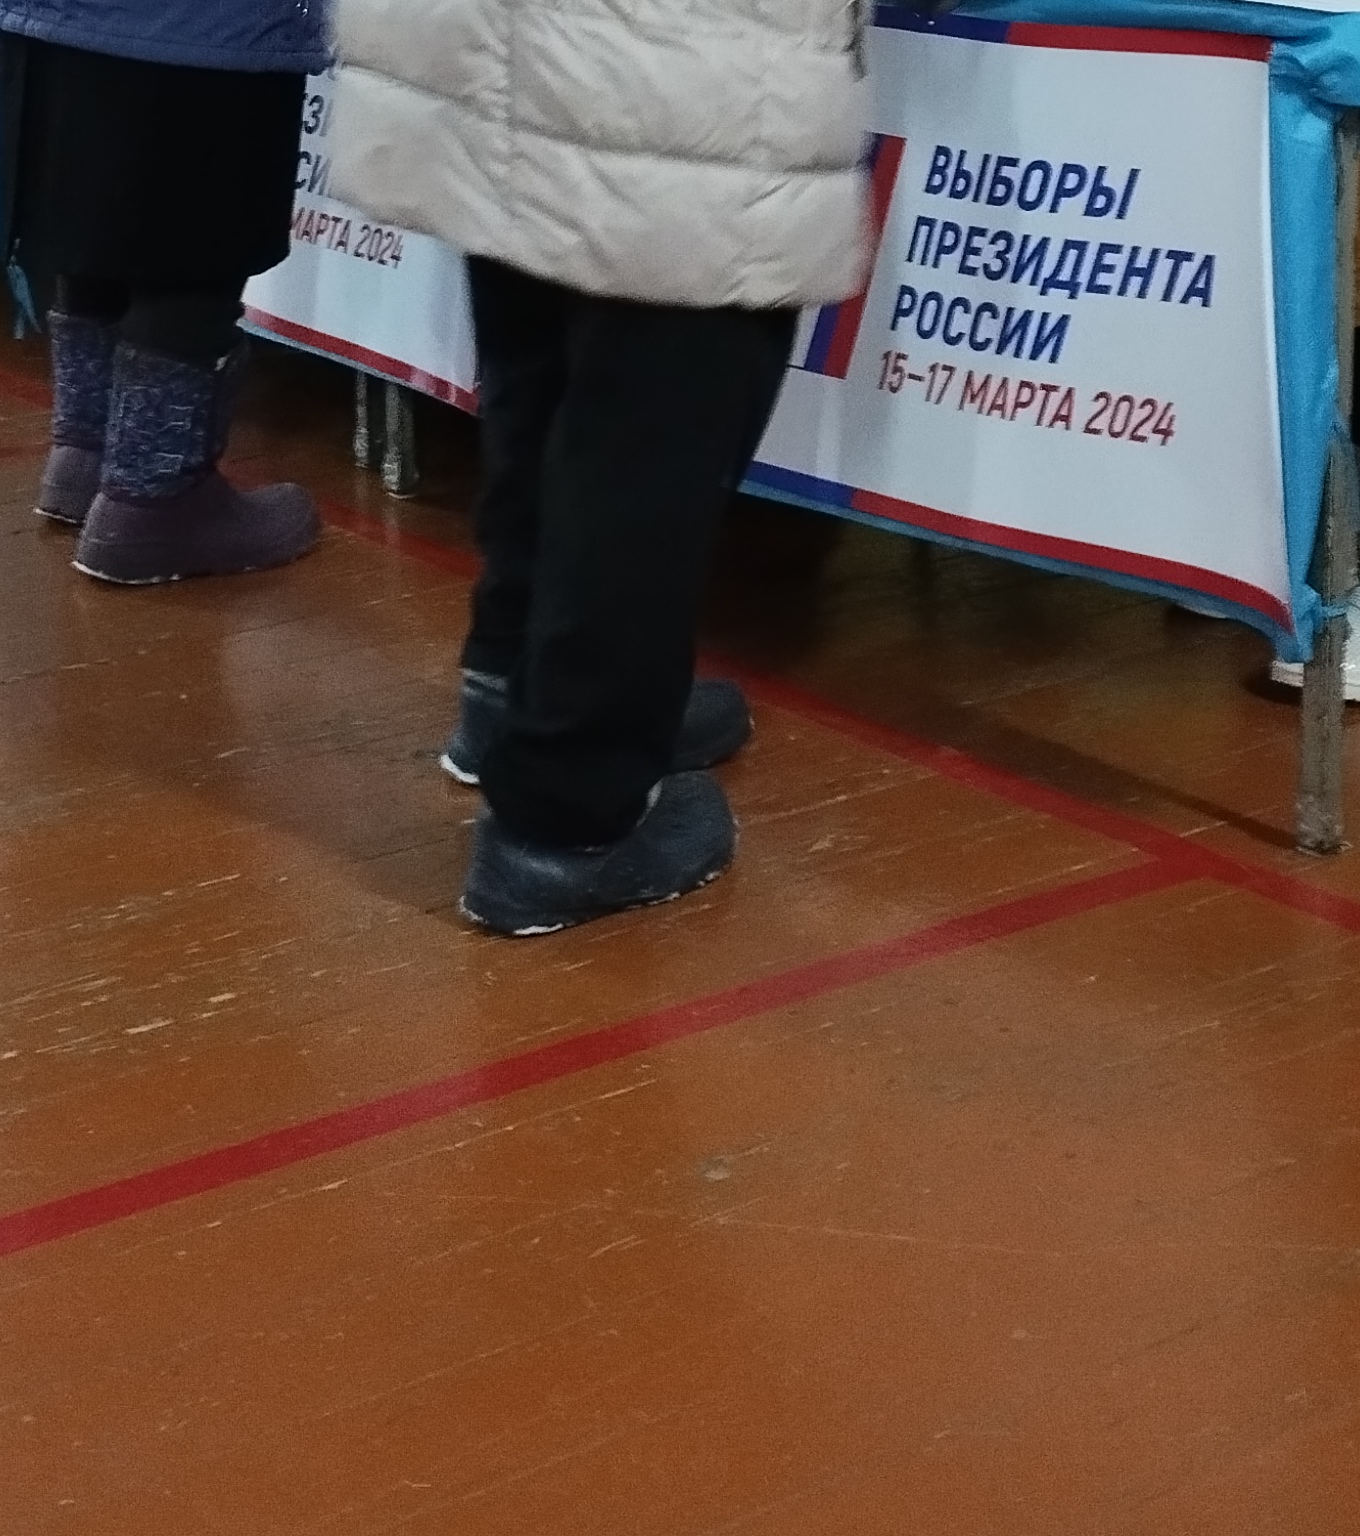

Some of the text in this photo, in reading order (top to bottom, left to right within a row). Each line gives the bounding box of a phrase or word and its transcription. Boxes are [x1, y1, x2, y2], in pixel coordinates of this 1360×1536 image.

[923, 144, 1141, 220] ВЫБОРЫ
[353, 224, 403, 269] 2024
[905, 215, 1217, 308] ПРЕЗИДЕНТА
[890, 284, 1070, 364] РОССИИ
[957, 369, 1076, 431] МАРТА
[1083, 390, 1177, 447] 2024
